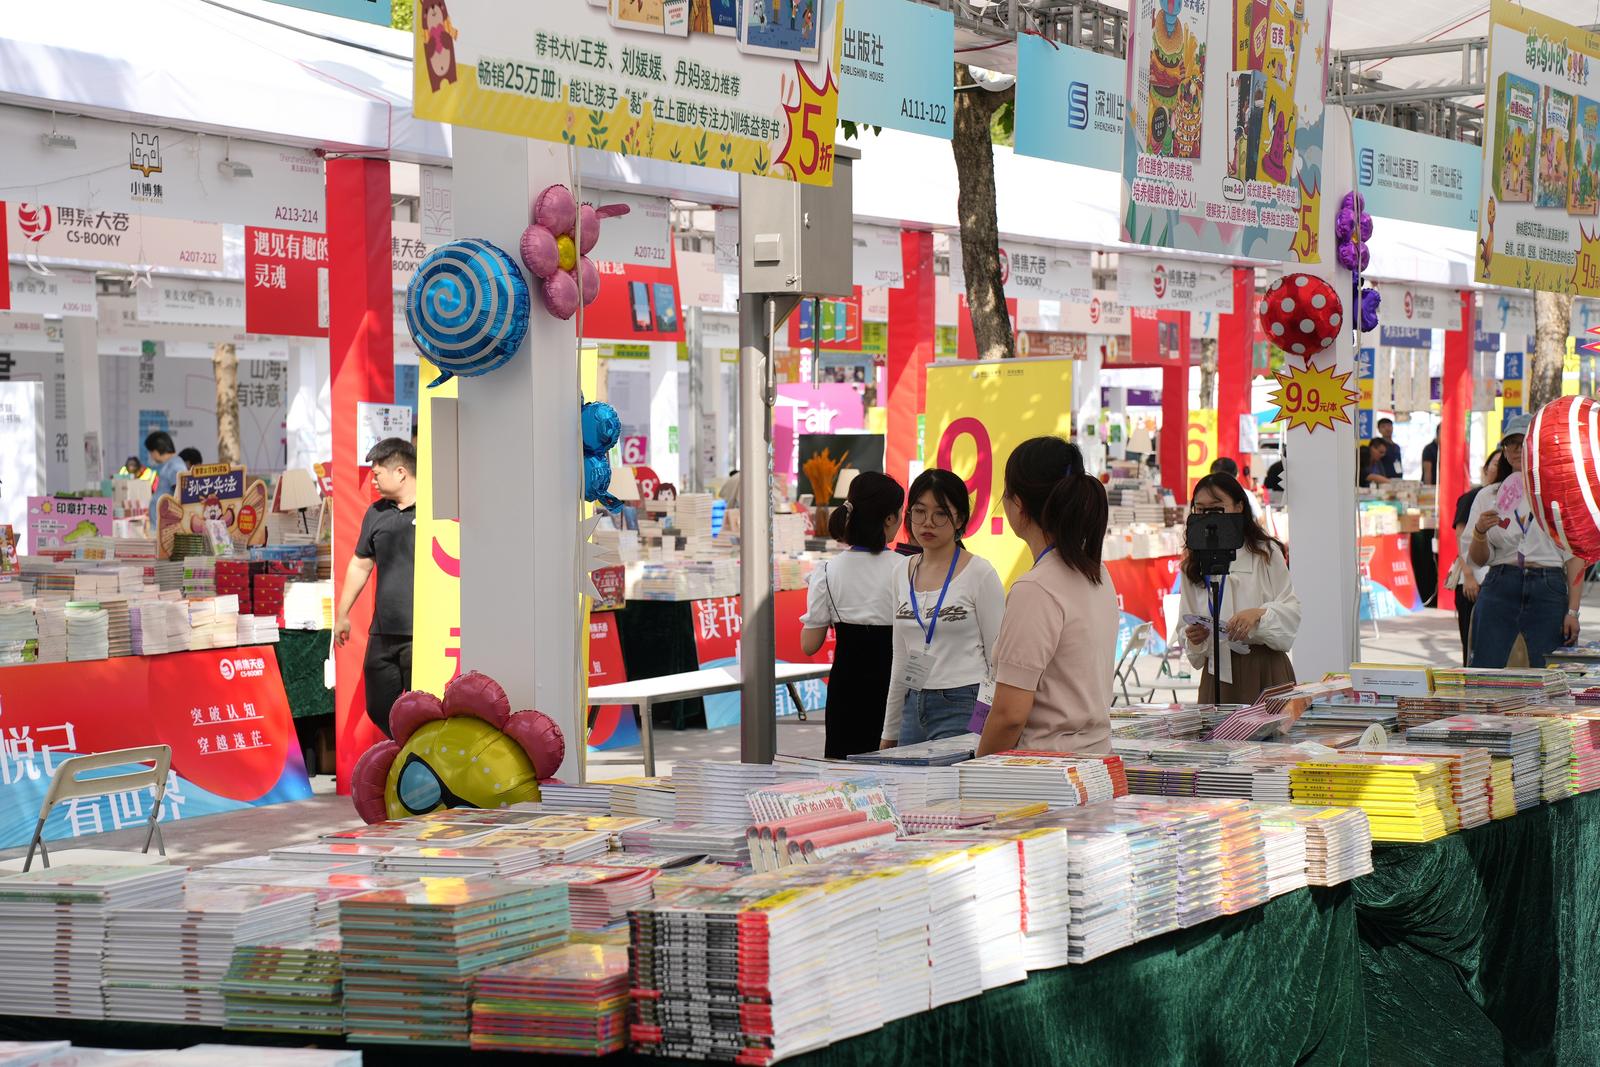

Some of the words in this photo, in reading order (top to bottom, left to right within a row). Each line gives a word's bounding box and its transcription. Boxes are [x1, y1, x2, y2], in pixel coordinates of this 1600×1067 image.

[844, 27, 884, 67] 出版社
[536, 32, 740, 97] 荐书大V王芳、刘媛媛、丹妈强力推荐
[841, 63, 867, 79] PUBLISHING
[868, 70, 884, 83] HOUSE
[901, 97, 946, 125] A111-122
[799, 102, 832, 176] 5折
[1094, 120, 1116, 134] SHENZHEN
[1378, 153, 1418, 181] 深圳出版集团
[1431, 164, 1462, 190] 深圳出版社
[131, 181, 163, 198] 小博集
[275, 206, 319, 224] A213-214
[66, 230, 120, 247] CS-BOOKY
[254, 231, 328, 261] 遇见有趣的
[179, 250, 217, 264] A207-212
[634, 245, 666, 260] A207-212
[1011, 252, 1047, 275] 博集天卷
[254, 263, 287, 289] 灵魂
[1285, 381, 1338, 414] 9.9元/本
[780, 394, 838, 434] Fair
[187, 475, 238, 496] 孙子兵法
[56, 502, 108, 516] 印章打卡处
[698, 596, 743, 640] 读书
[190, 701, 257, 724] 突破认知
[197, 729, 264, 754] 穿越迷茫
